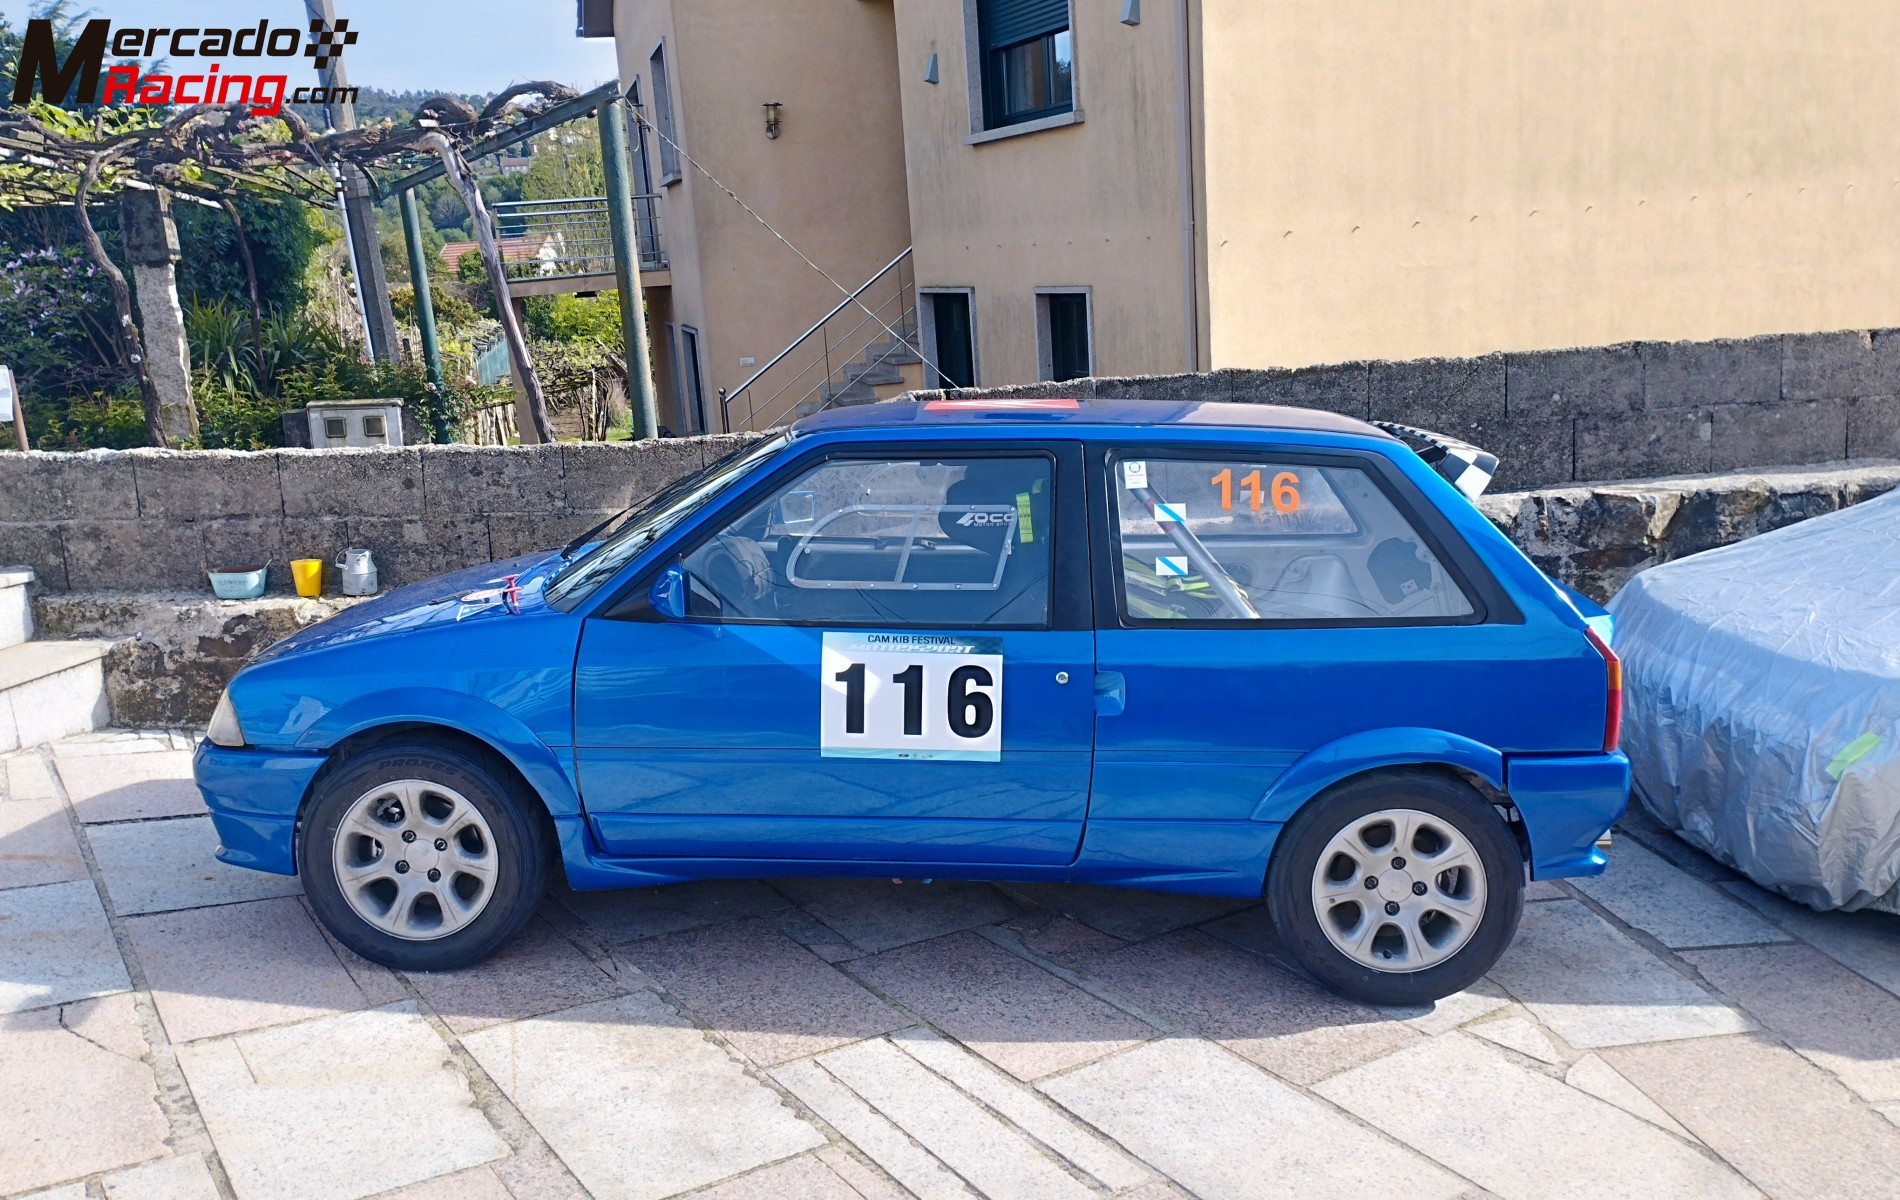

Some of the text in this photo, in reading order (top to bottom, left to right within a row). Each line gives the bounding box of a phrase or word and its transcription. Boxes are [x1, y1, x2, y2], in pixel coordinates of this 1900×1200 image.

[1211, 468, 1300, 513] 116
[867, 634, 956, 645] CAM KIB FESTIVAL
[835, 663, 993, 738] 116
[379, 759, 458, 775] PROXES
